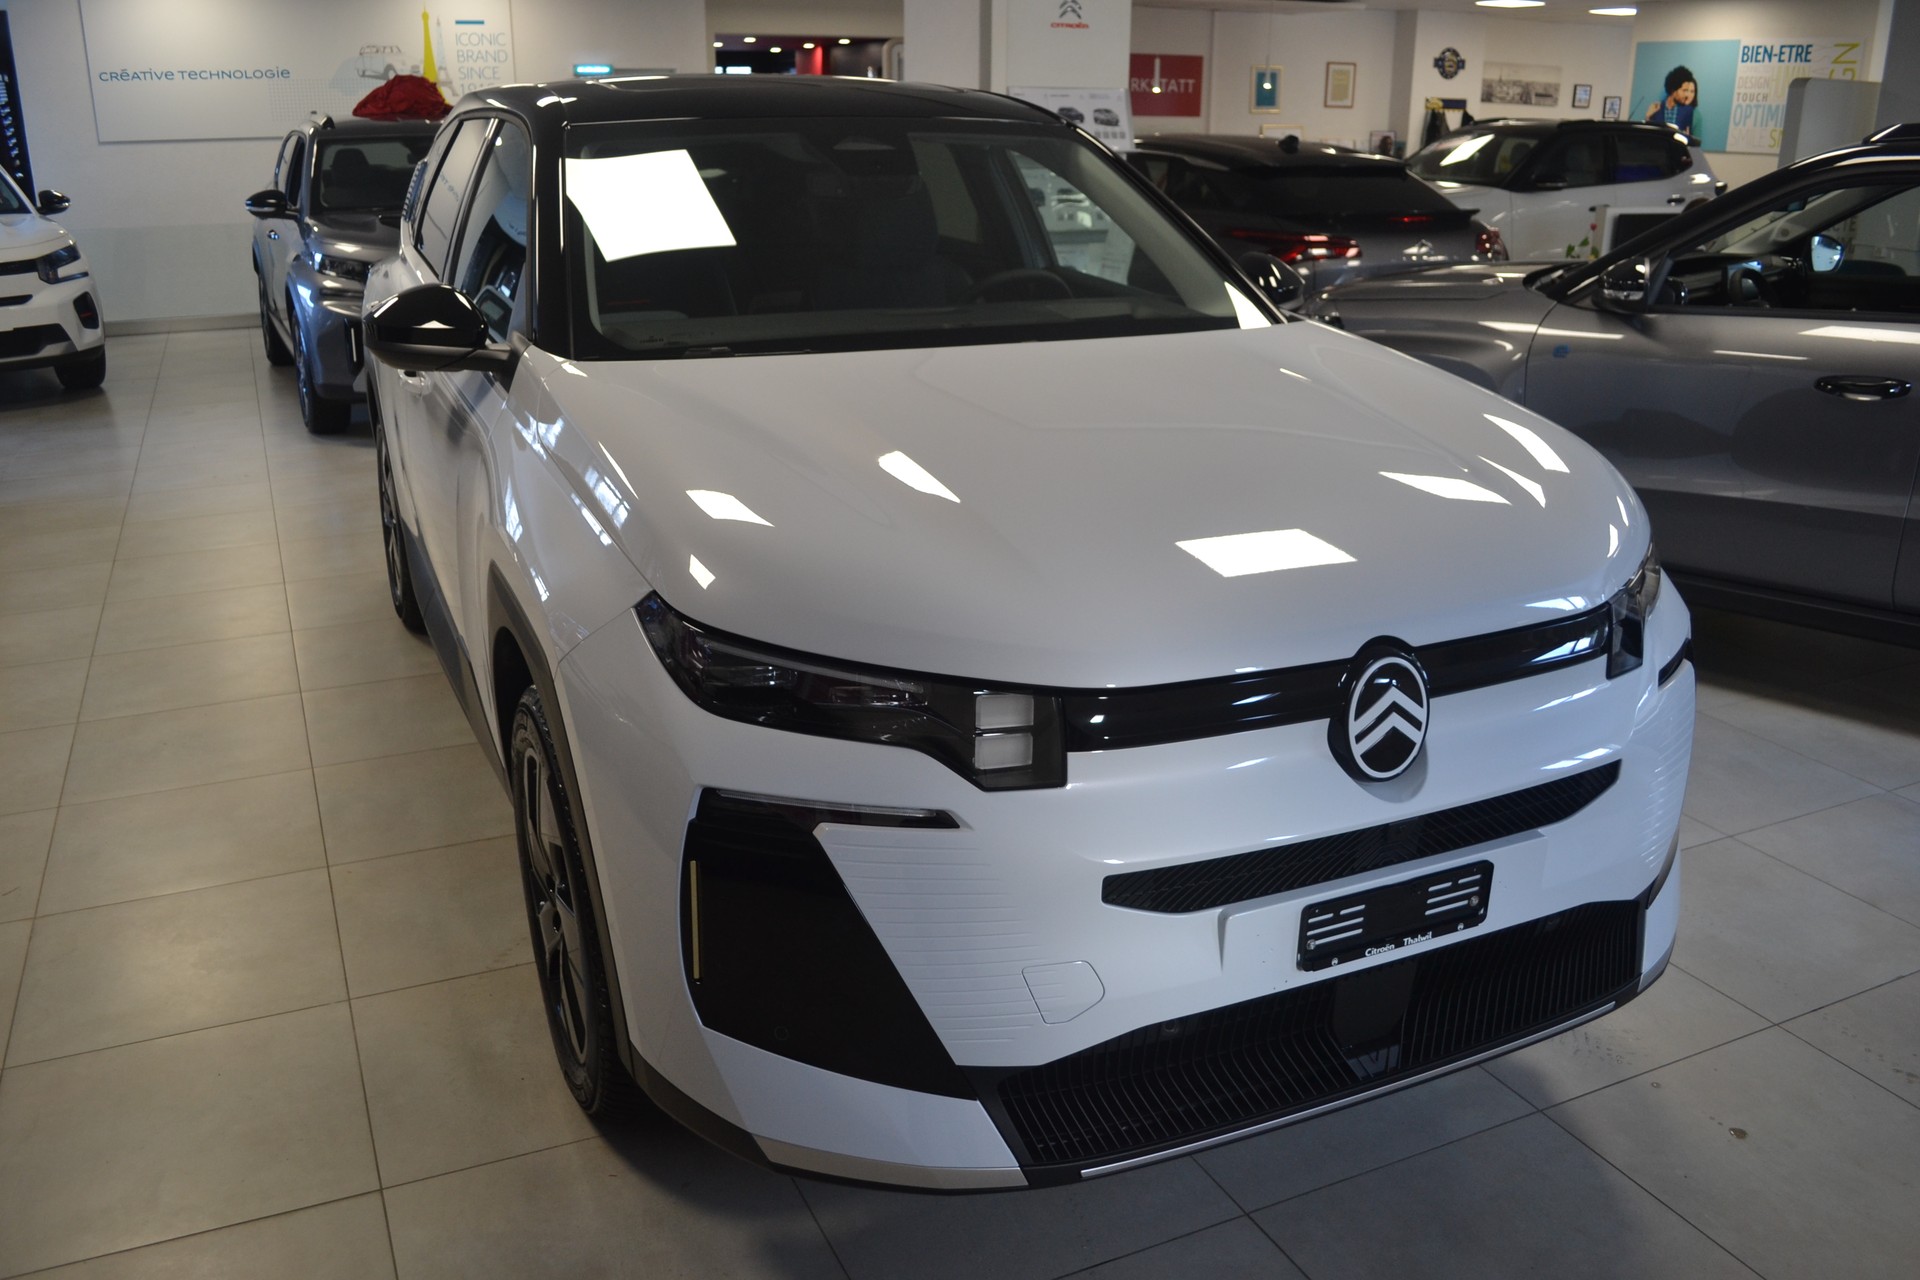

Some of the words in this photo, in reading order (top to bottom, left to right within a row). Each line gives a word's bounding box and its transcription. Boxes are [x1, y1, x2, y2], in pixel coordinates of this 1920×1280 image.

[456, 33, 506, 46] ICONIC
[457, 49, 508, 63] BRAND
[1741, 45, 1813, 63] BIEN-ETRE
[458, 66, 500, 80] SINCE
[1131, 78, 1196, 93] RKTATT
[1737, 92, 1769, 103] TOUCH
[1364, 943, 1396, 957] Citroën
[1403, 931, 1433, 946] Thalwil
